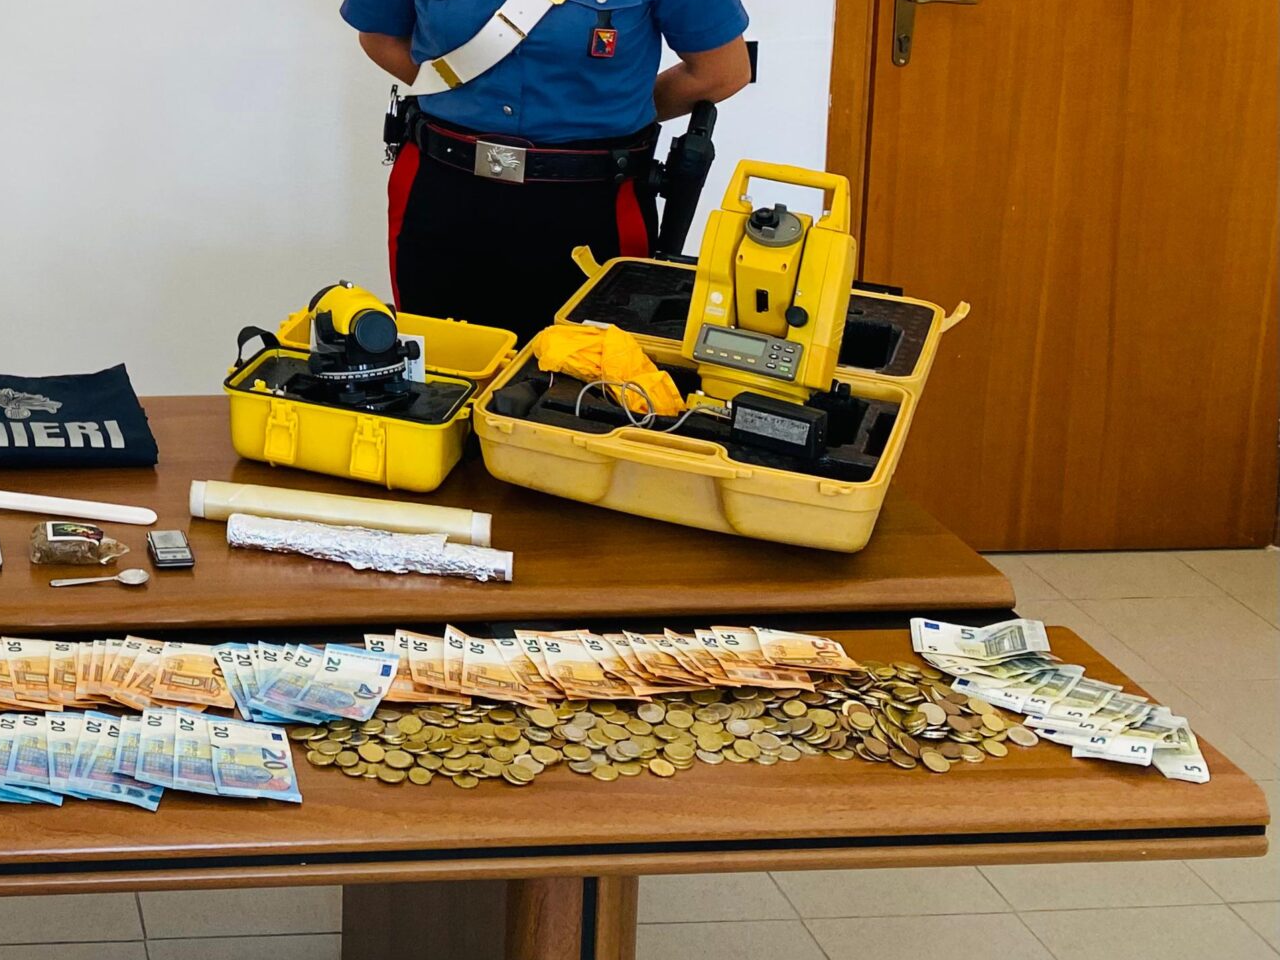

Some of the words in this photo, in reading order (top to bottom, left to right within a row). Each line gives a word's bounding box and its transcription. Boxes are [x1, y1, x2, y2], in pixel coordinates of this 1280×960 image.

[721, 634, 740, 646] 50
[960, 628, 975, 640] 5
[7, 641, 22, 652] 50
[370, 639, 385, 653] 50
[413, 640, 428, 652] 50
[470, 642, 485, 655] 50
[524, 639, 541, 653] 50
[545, 641, 561, 653] 50
[586, 639, 603, 652] 50
[219, 651, 234, 663] 20
[236, 654, 252, 667] 20
[263, 650, 278, 663] 20
[295, 655, 312, 668] 20
[325, 656, 341, 672] 20
[1068, 710, 1083, 719] 5
[0, 718, 16, 730] 20
[23, 716, 39, 727] 20
[51, 720, 65, 732] 20
[147, 715, 162, 727] 20
[180, 718, 195, 731] 20
[1079, 721, 1095, 730] 5
[86, 721, 102, 734] 20
[213, 726, 229, 739] 20
[1090, 736, 1106, 745] 5
[1131, 745, 1147, 754] 5
[261, 748, 288, 770] 20
[1184, 764, 1202, 773] 5
